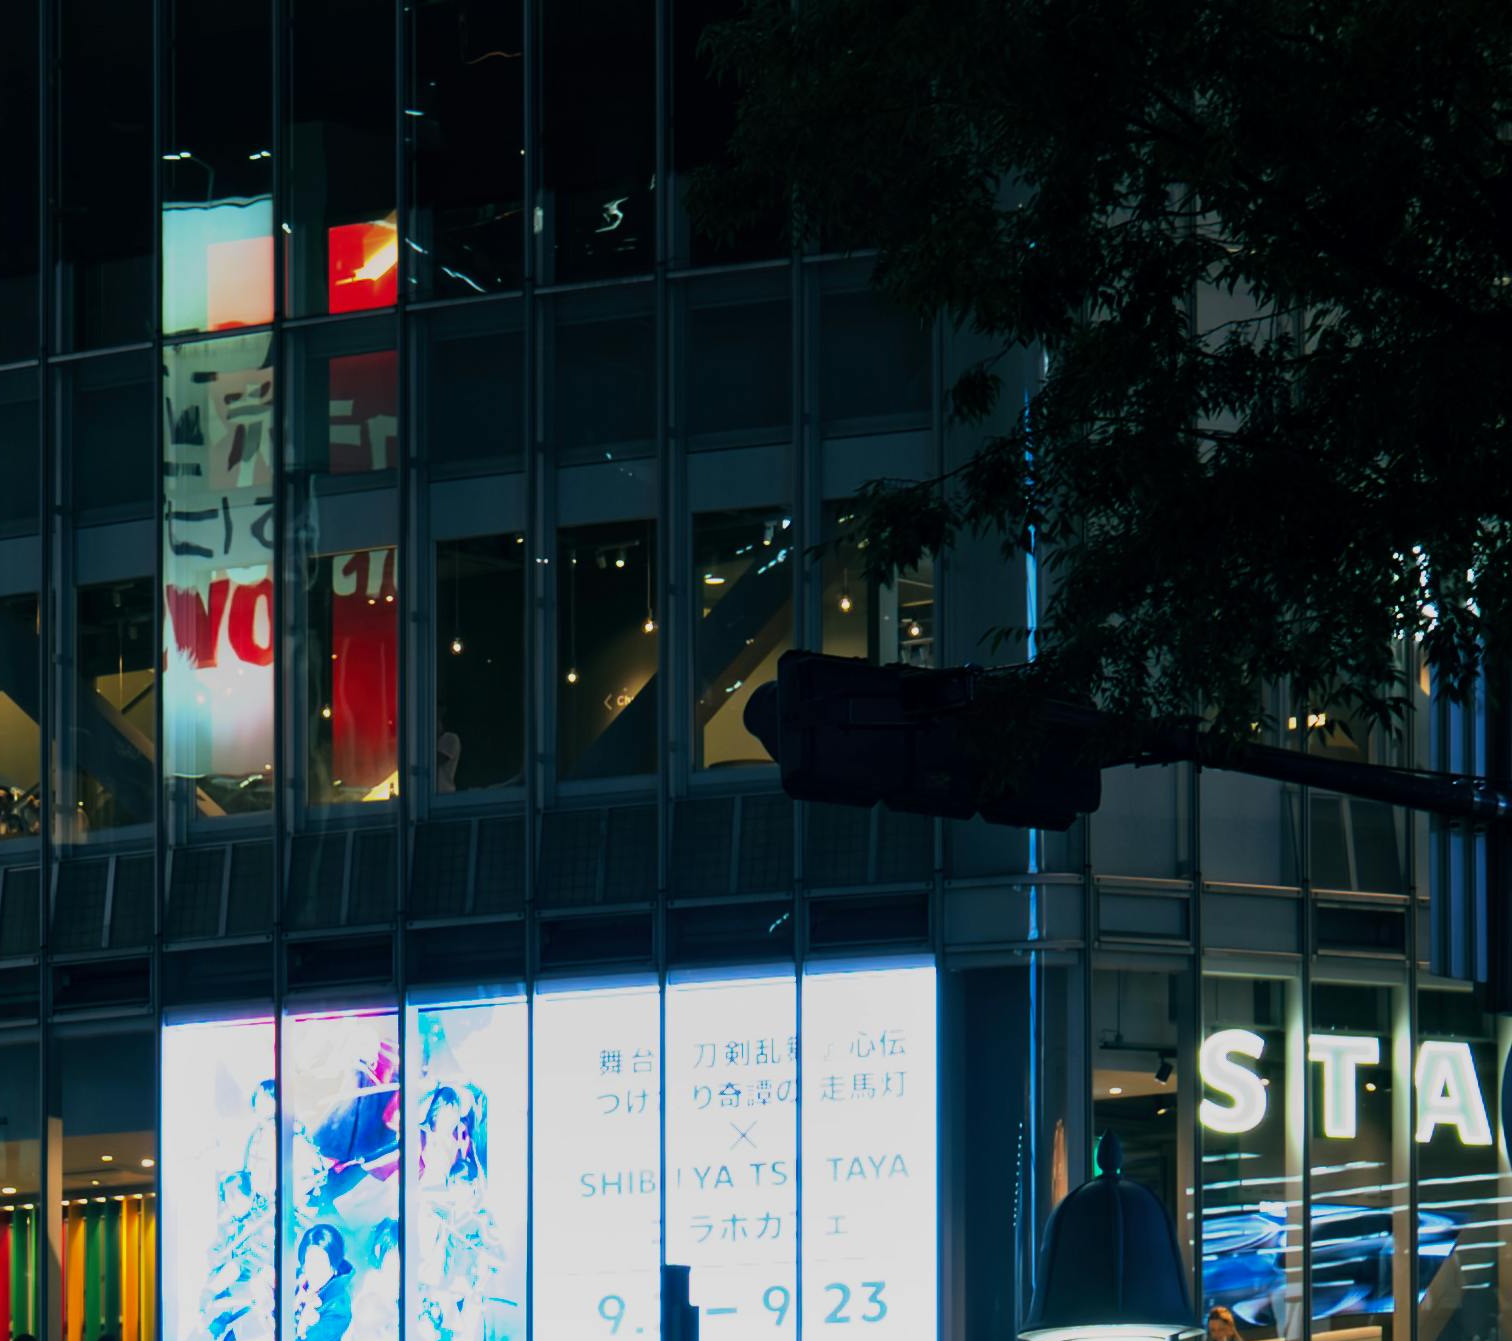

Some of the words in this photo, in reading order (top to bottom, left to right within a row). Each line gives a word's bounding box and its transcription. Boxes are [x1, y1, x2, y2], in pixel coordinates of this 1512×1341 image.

[597, 1071, 906, 1116] つけり奇譚の走馬灯
[580, 1165, 735, 1199] SHIBYA
[749, 1152, 909, 1188] TSTAYA
